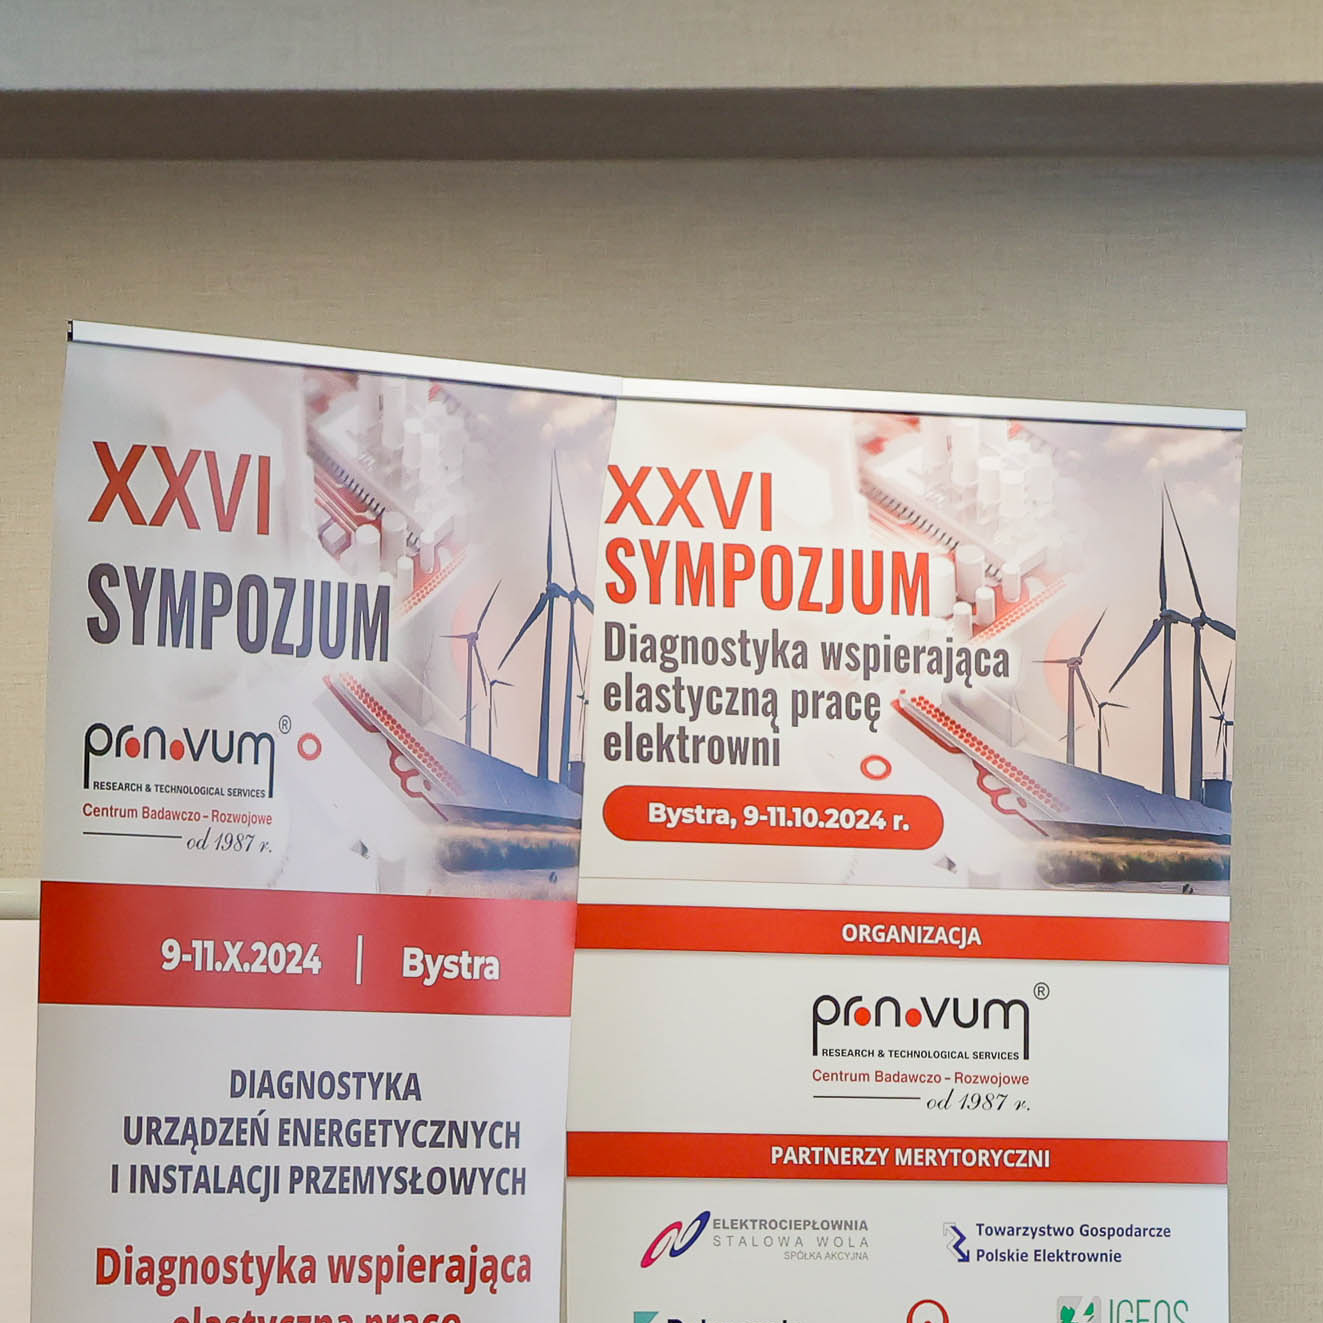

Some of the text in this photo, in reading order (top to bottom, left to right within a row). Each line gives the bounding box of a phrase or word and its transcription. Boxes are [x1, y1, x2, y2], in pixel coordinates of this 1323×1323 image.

[88, 441, 270, 535] XXVI
[604, 465, 772, 531] XXVI
[605, 537, 930, 616] SYMPOZJUM
[87, 563, 390, 662] SYMPOZJUM
[605, 621, 1010, 687] Diagnostyka wspierająca
[604, 672, 880, 738] elastyczną pracę
[603, 721, 781, 767] elektrowni
[155, 784, 224, 796] TECHNOLOGICAL
[83, 803, 272, 827] Centrum Badawczo Rozwojowe
[648, 803, 886, 829] Bystra, 9-11.10.2024
[187, 827, 254, 852] od 1987
[843, 924, 981, 949] ORGANIZACJA
[160, 937, 499, 988] 9-11.X.2024 Bystra
[822, 1049, 1019, 1060] RESEARCH TECHNOLOGICAL SERVICES
[230, 1070, 421, 1101] DIAGNOSTYKA
[813, 1069, 1029, 1087] Centrum Badawczo Rozwojowe
[927, 1089, 1008, 1110] od 1987
[124, 1109, 520, 1155] URZĄDZEŃ ENERGETYCZNYCH
[772, 1147, 1049, 1167] PARTNERZY MERYTORYCZNI
[130, 1165, 525, 1202] INSTALACJI PRZEMYSŁOWYCH
[713, 1219, 868, 1231] ELEKTROCIEPŁOWNIA
[976, 1224, 1170, 1240] Towarzystwo Gospodarcze
[713, 1235, 868, 1248] STALOWA WOLA
[977, 1249, 1121, 1262] Polskie Elektrownie
[96, 1244, 531, 1296] Diagnostyka wspierająca
